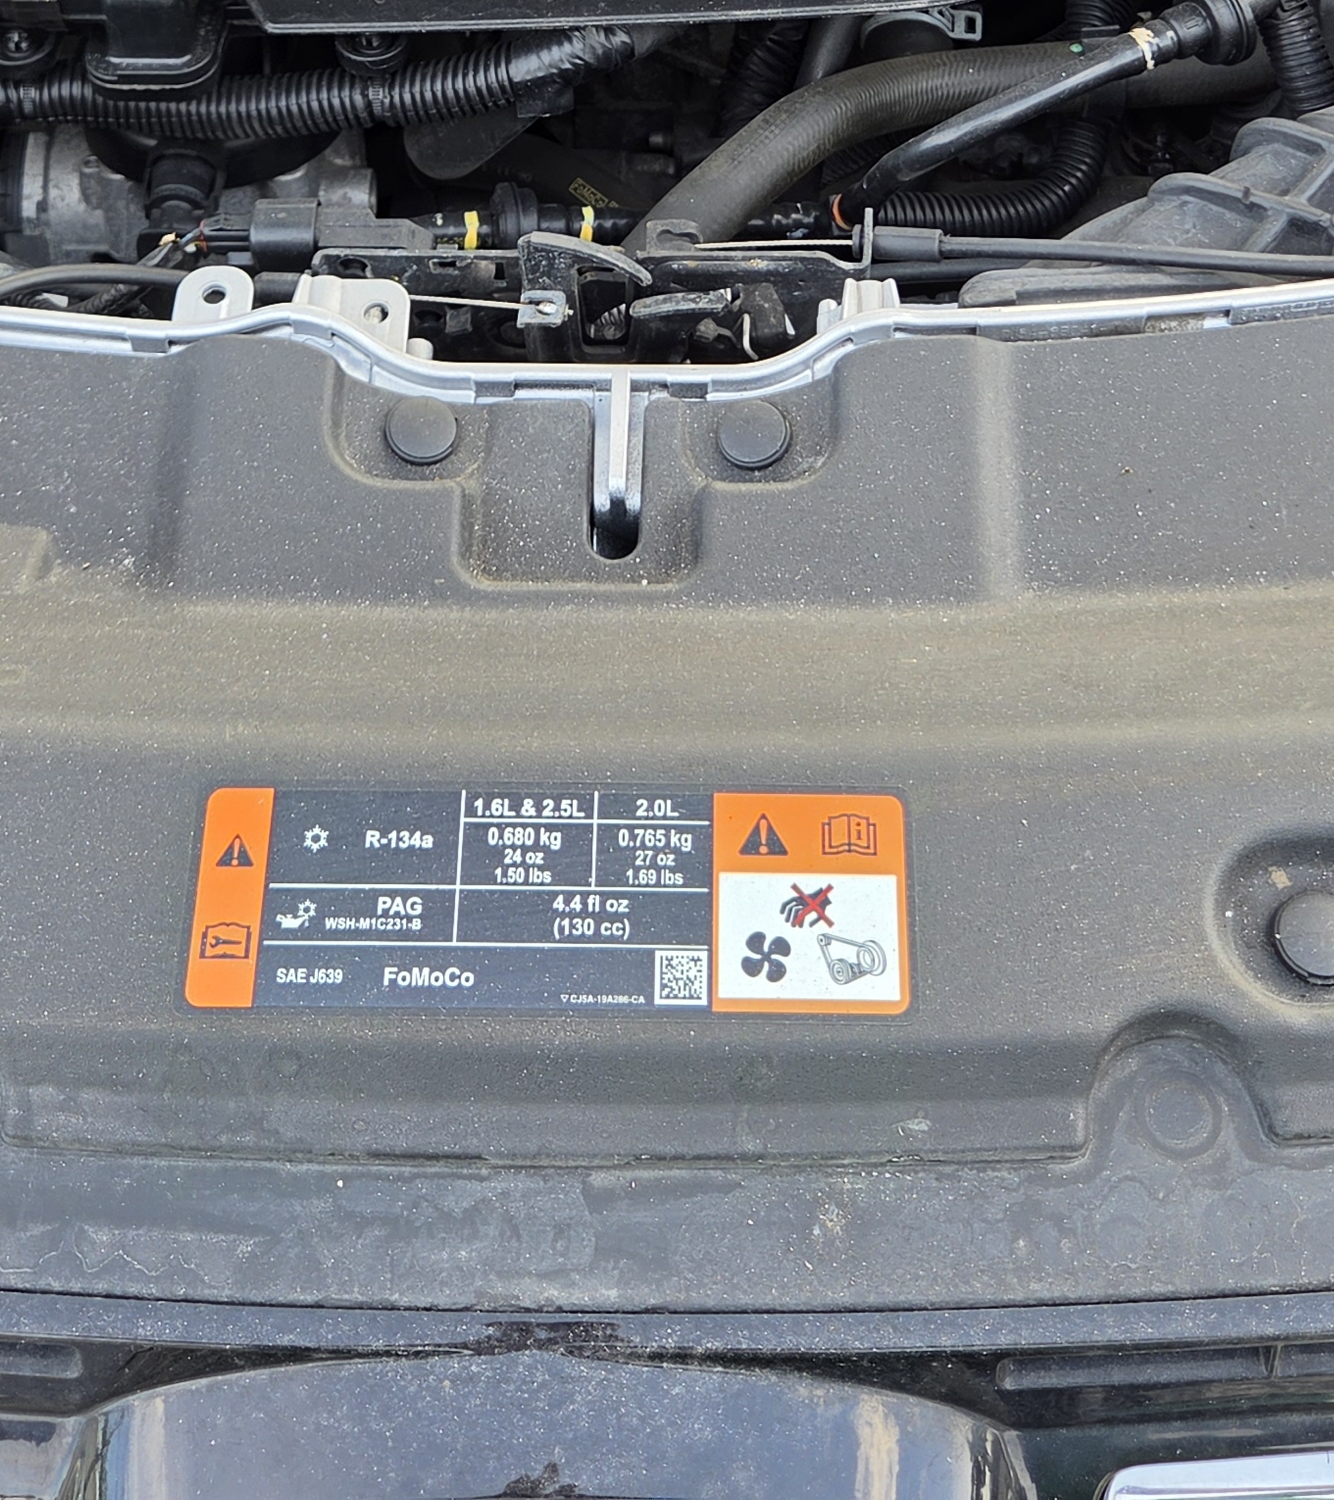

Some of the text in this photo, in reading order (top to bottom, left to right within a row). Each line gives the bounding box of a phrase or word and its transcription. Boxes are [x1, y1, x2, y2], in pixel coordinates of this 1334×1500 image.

[473, 798, 585, 818] 1.6L & 2.5L
[636, 799, 679, 818] 2.0L
[365, 830, 434, 849] R-134a
[488, 827, 562, 850] 0.680 kg
[618, 829, 692, 851] 0.765 kg
[503, 849, 544, 864] 24 oz
[634, 851, 676, 866] 27 oz
[494, 867, 552, 883] 1.50 lbs
[626, 869, 684, 885] 1.69 lbs
[377, 896, 423, 915] PAG
[552, 895, 630, 913] 4.4 fl oz
[325, 917, 422, 930] WSH-M1C231-B
[553, 917, 630, 940] (130 cc)
[276, 968, 343, 983] SAE J639
[383, 967, 475, 987] FoMoCo
